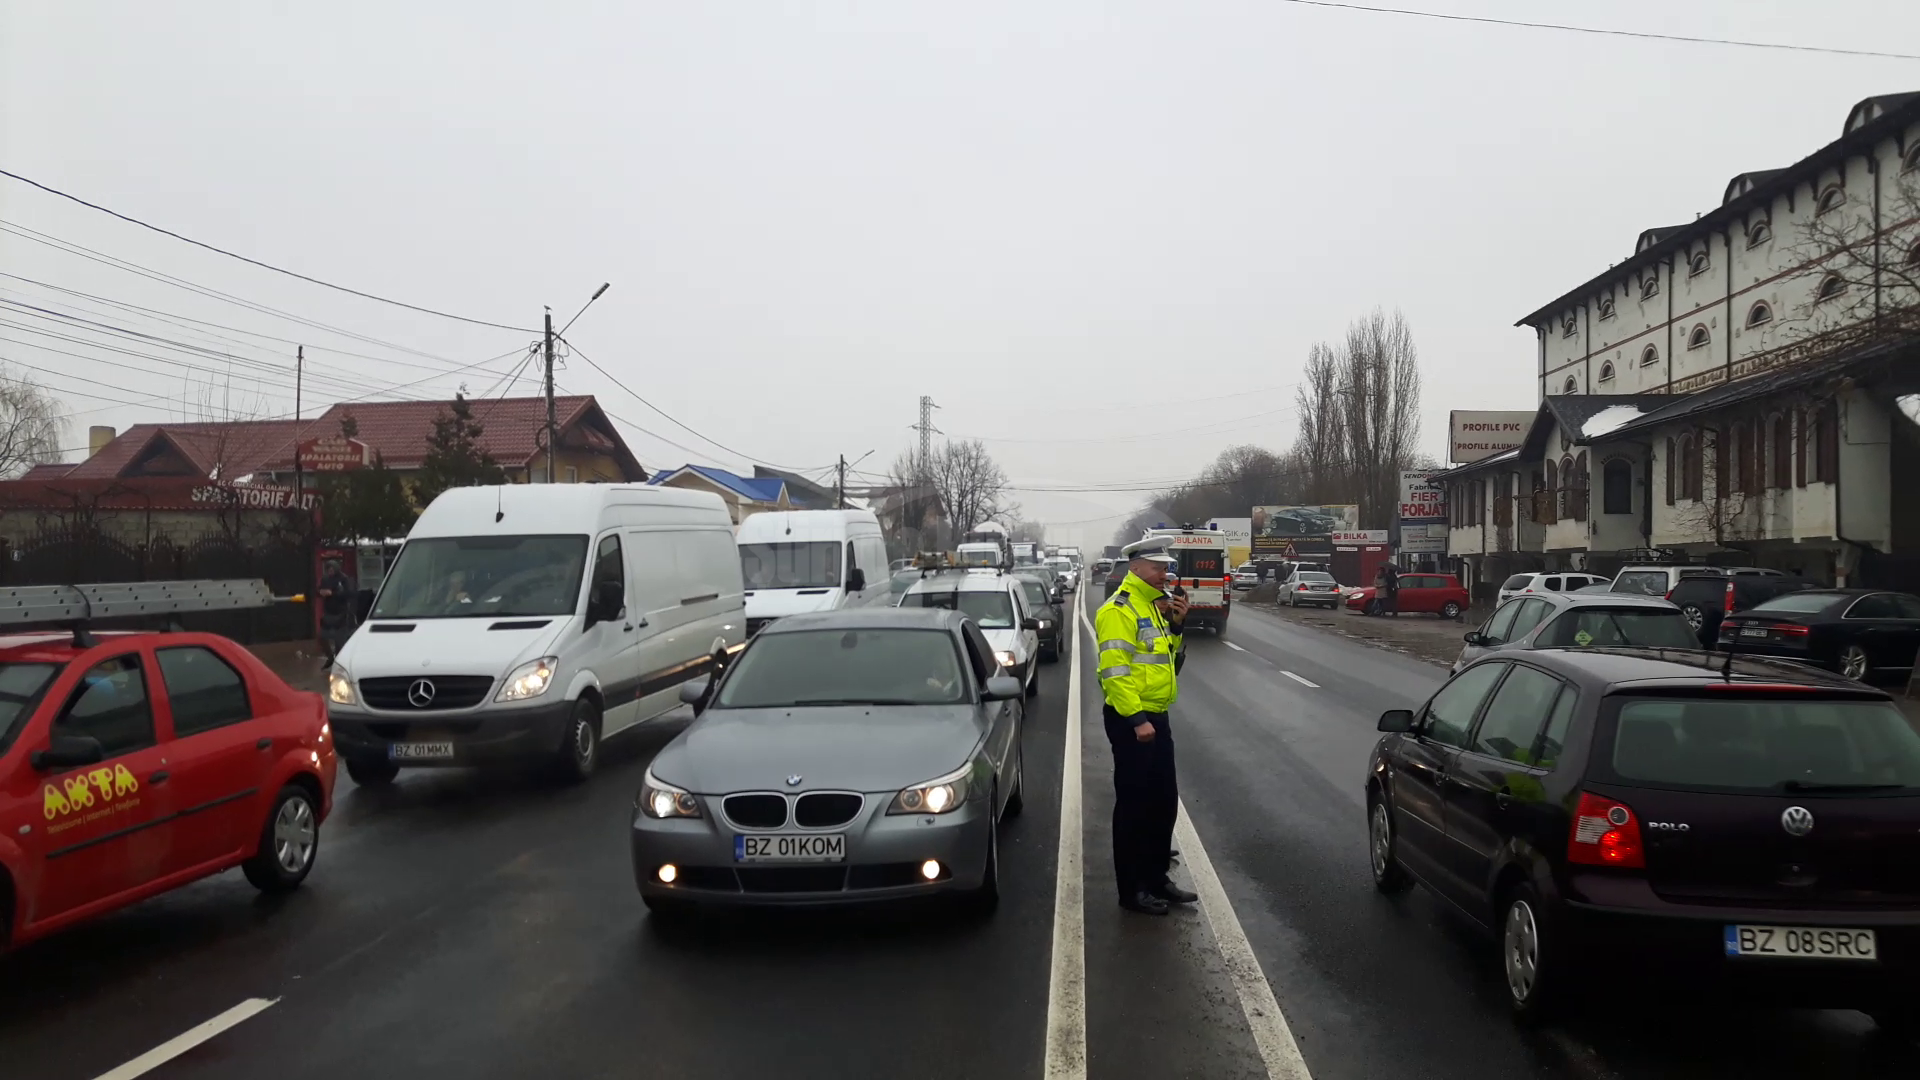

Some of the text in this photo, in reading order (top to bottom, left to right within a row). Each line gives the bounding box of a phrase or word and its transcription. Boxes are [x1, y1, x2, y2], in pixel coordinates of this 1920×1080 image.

[1462, 423, 1520, 431] PROFILE PVC
[316, 462, 345, 471] AUTO
[1411, 492, 1438, 501] FIER
[1401, 503, 1446, 517] FORJAT
[1343, 532, 1368, 540] BILKA
[1200, 560, 1215, 569] 112
[395, 744, 449, 757] BZ 01MMX
[43, 763, 139, 820] AKTA
[1648, 821, 1690, 832] POLO
[745, 837, 842, 856] BZ 01KOM
[1739, 928, 1872, 955] BZ 08SRC
